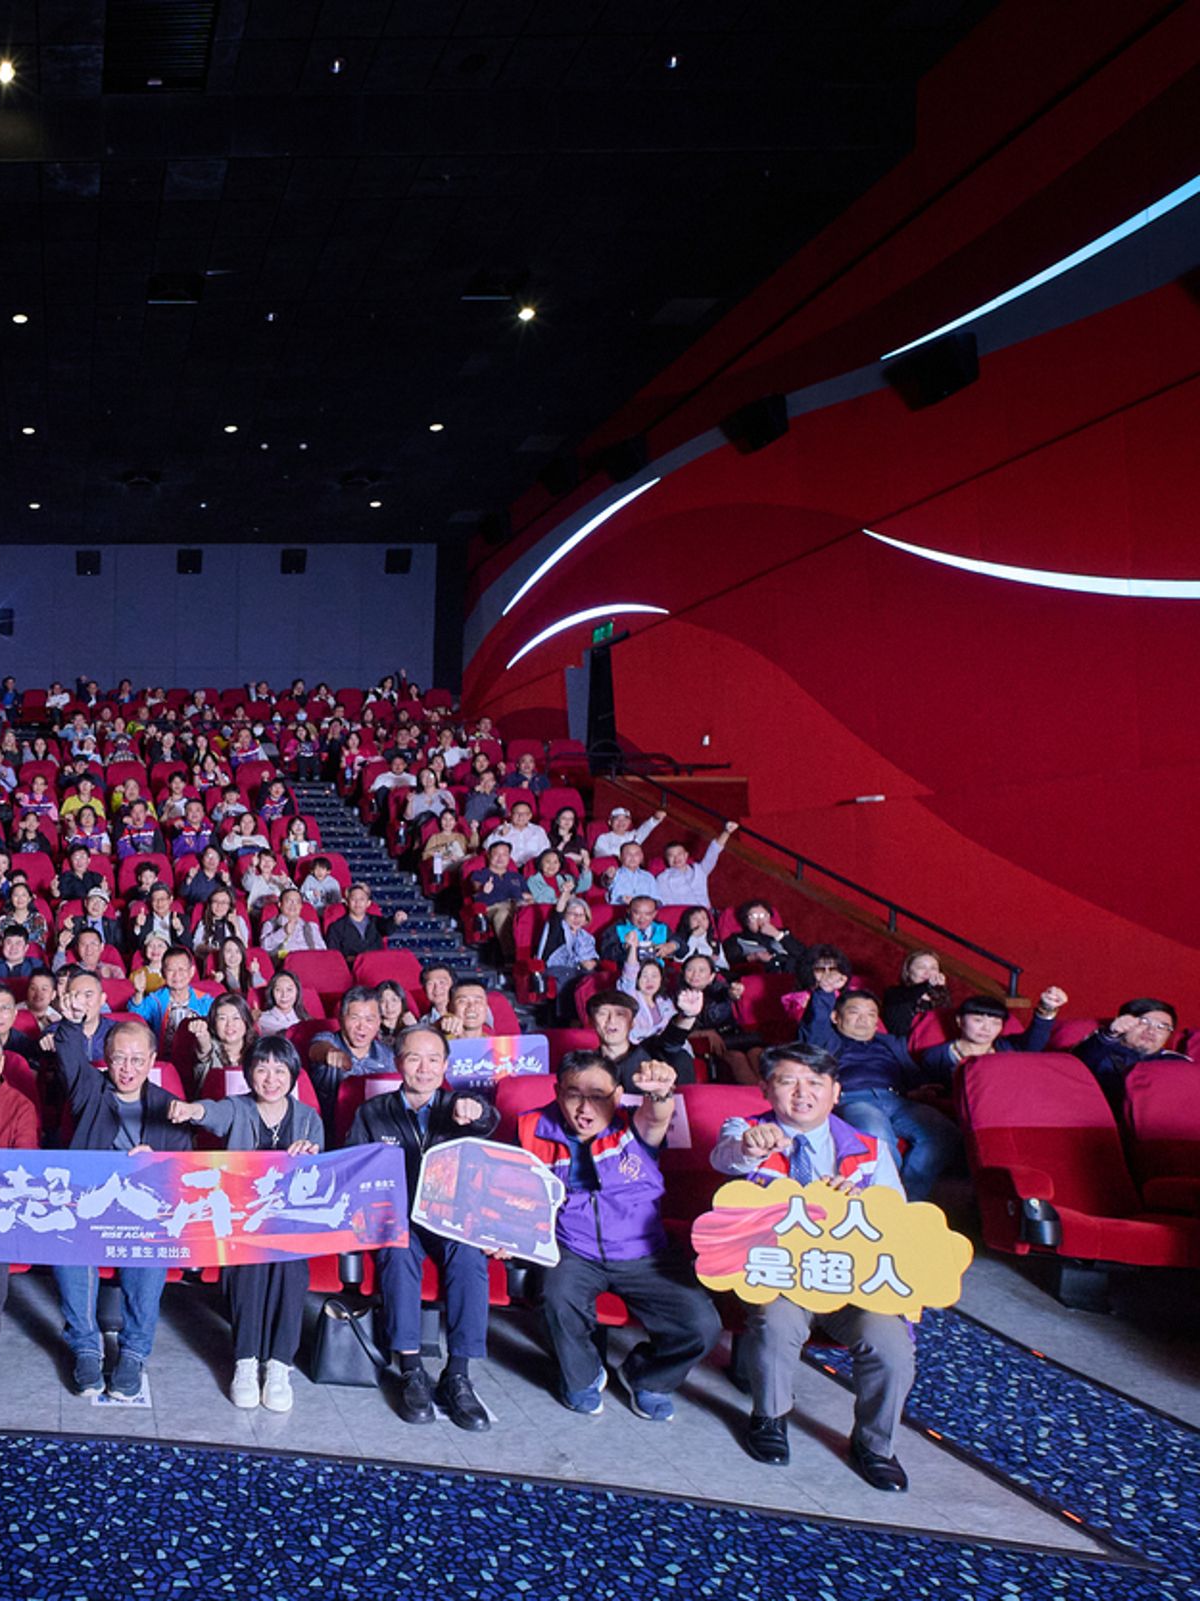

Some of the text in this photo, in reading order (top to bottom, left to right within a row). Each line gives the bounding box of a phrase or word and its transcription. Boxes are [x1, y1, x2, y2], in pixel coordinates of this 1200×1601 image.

[101, 1231, 156, 1239] RISE AGAIN
[772, 1194, 883, 1242] 人人
[744, 1246, 913, 1299] 是超人
